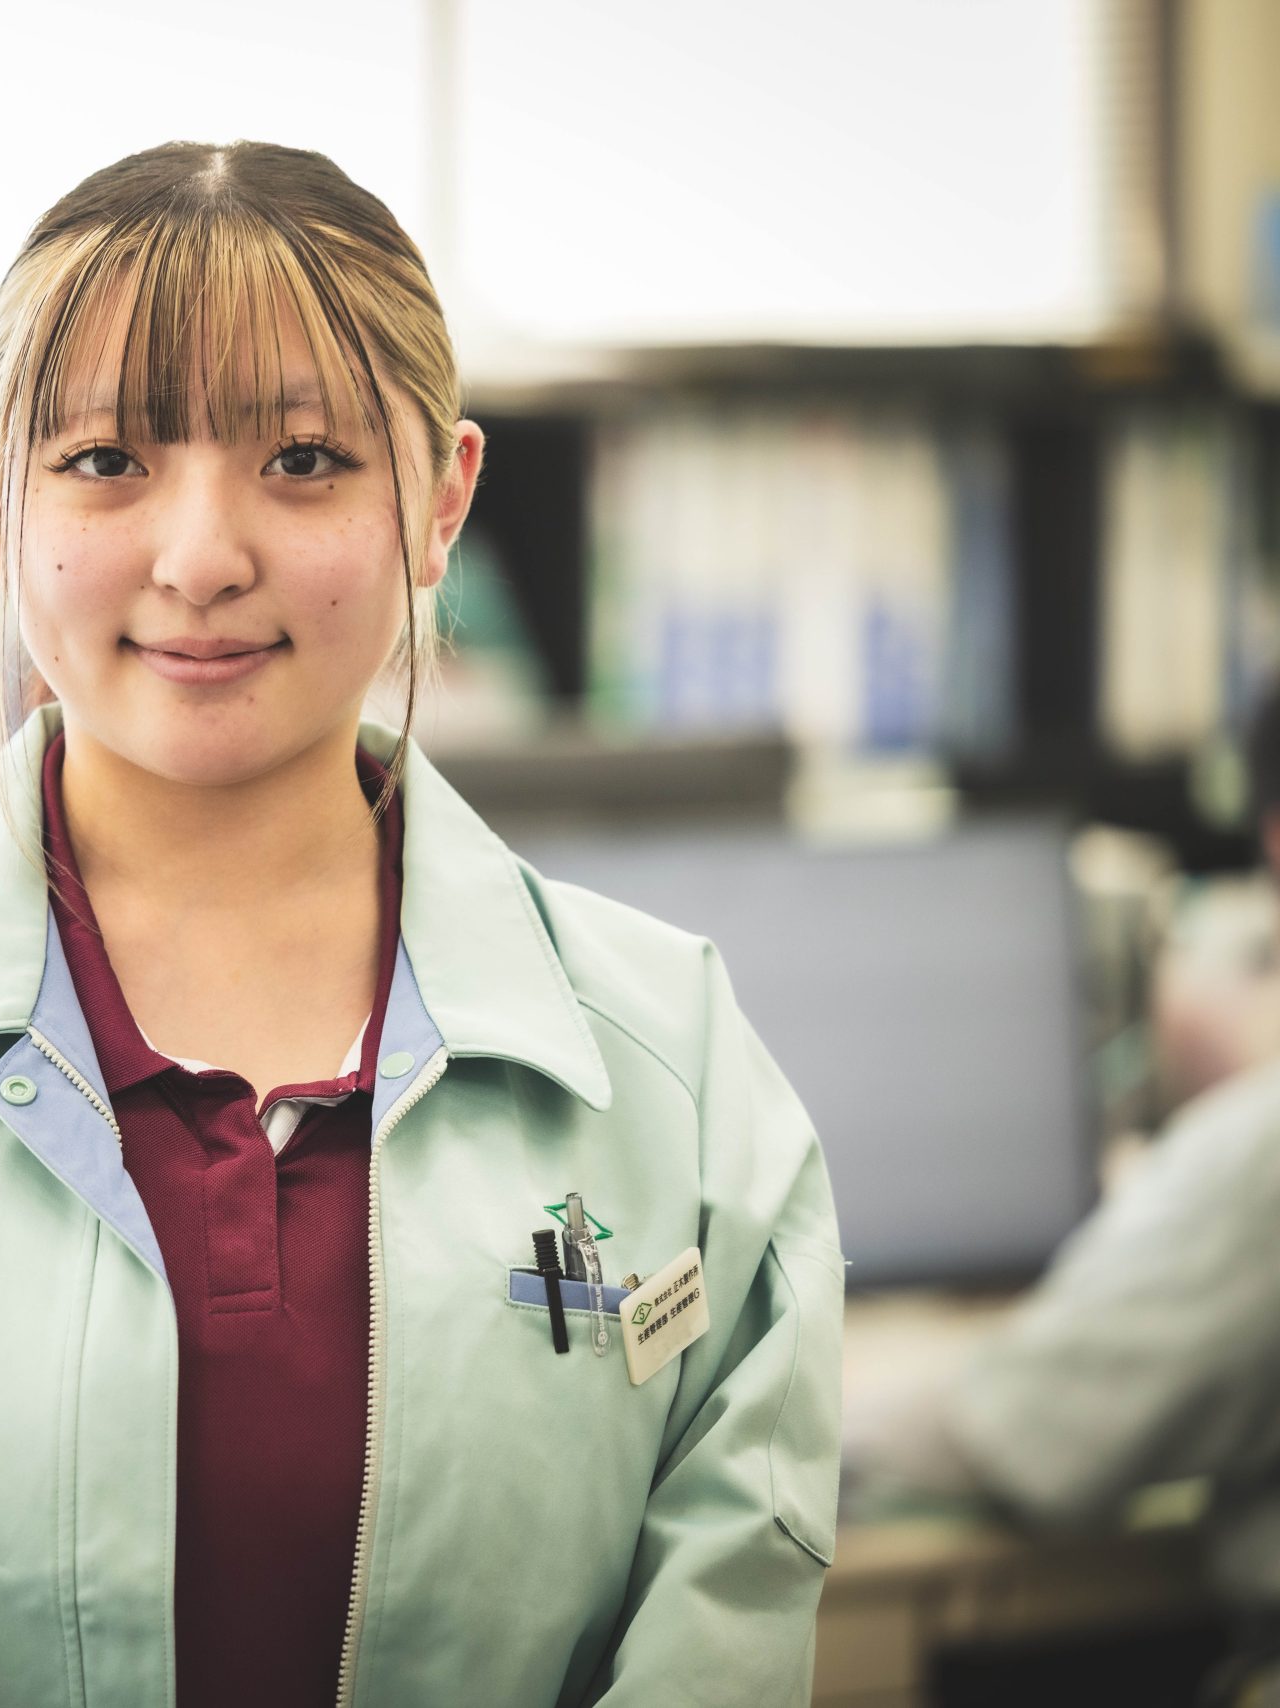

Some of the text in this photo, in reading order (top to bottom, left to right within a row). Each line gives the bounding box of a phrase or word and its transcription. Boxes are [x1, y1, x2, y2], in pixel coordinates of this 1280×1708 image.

[654, 1287, 672, 1307] 株式会社
[637, 1288, 700, 1345] 生産管理部 生産管理G
